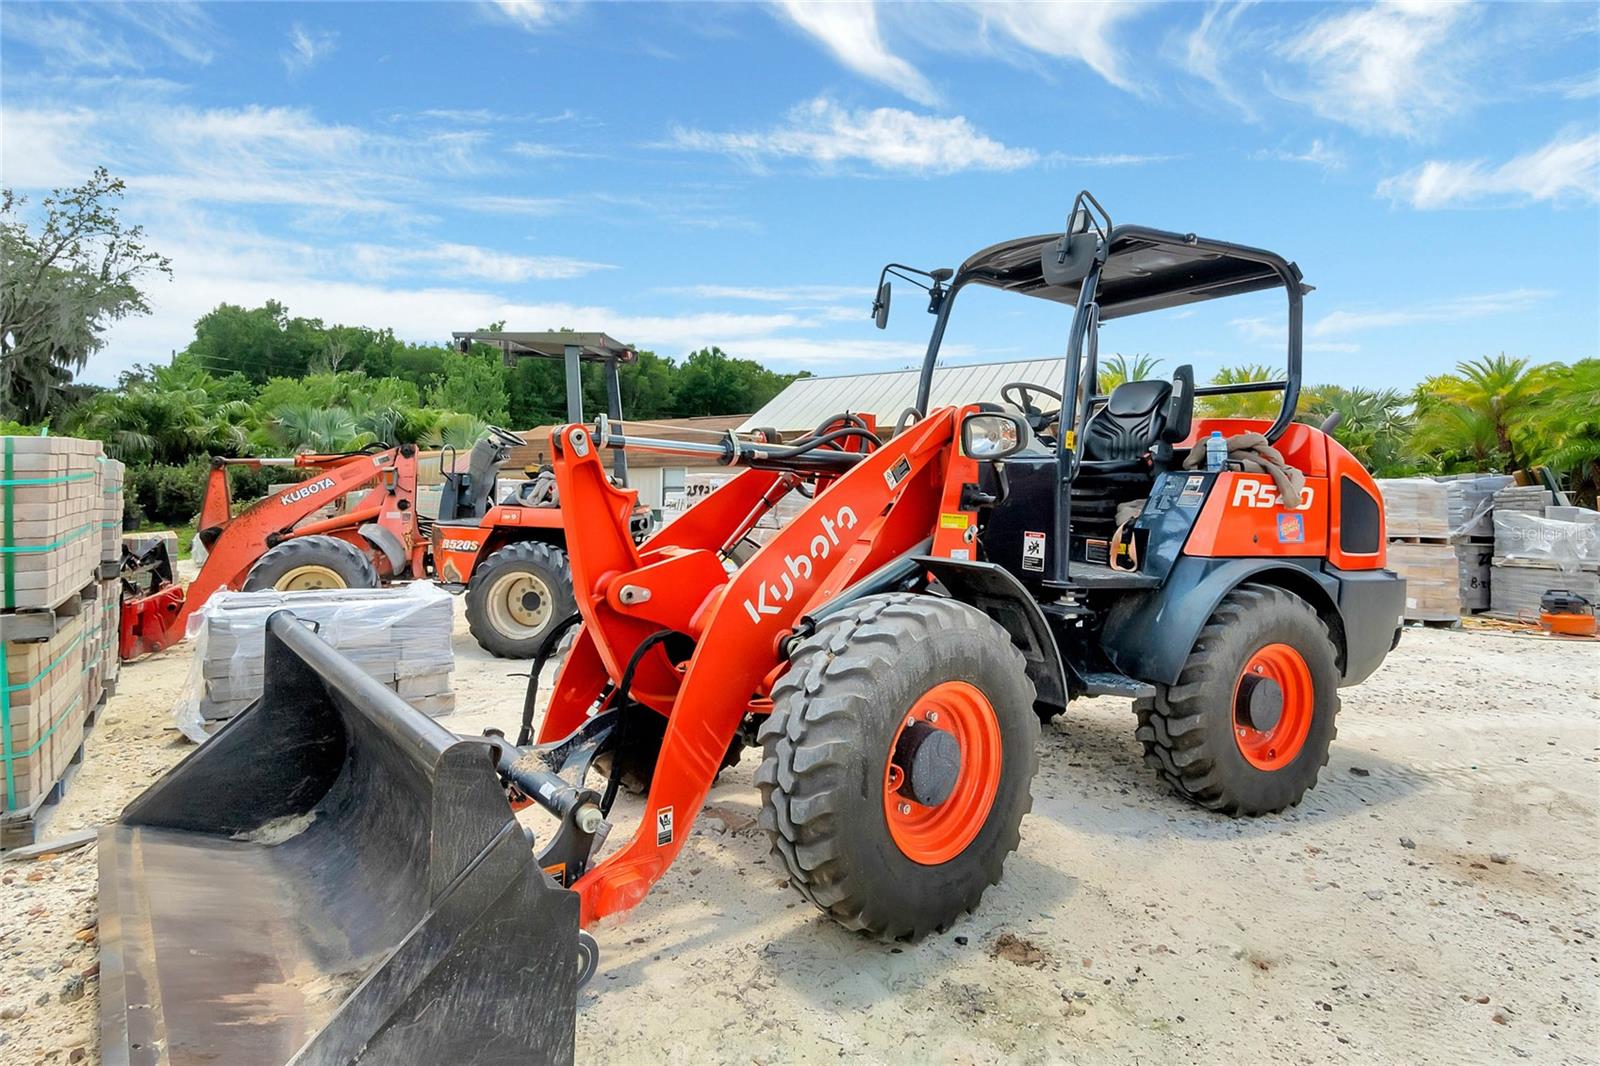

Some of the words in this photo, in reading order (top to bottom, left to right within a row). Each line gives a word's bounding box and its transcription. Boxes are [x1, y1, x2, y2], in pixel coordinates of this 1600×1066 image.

[281, 478, 336, 505] KUBOTA
[441, 539, 479, 551] R520S
[743, 506, 858, 624] Kubota
